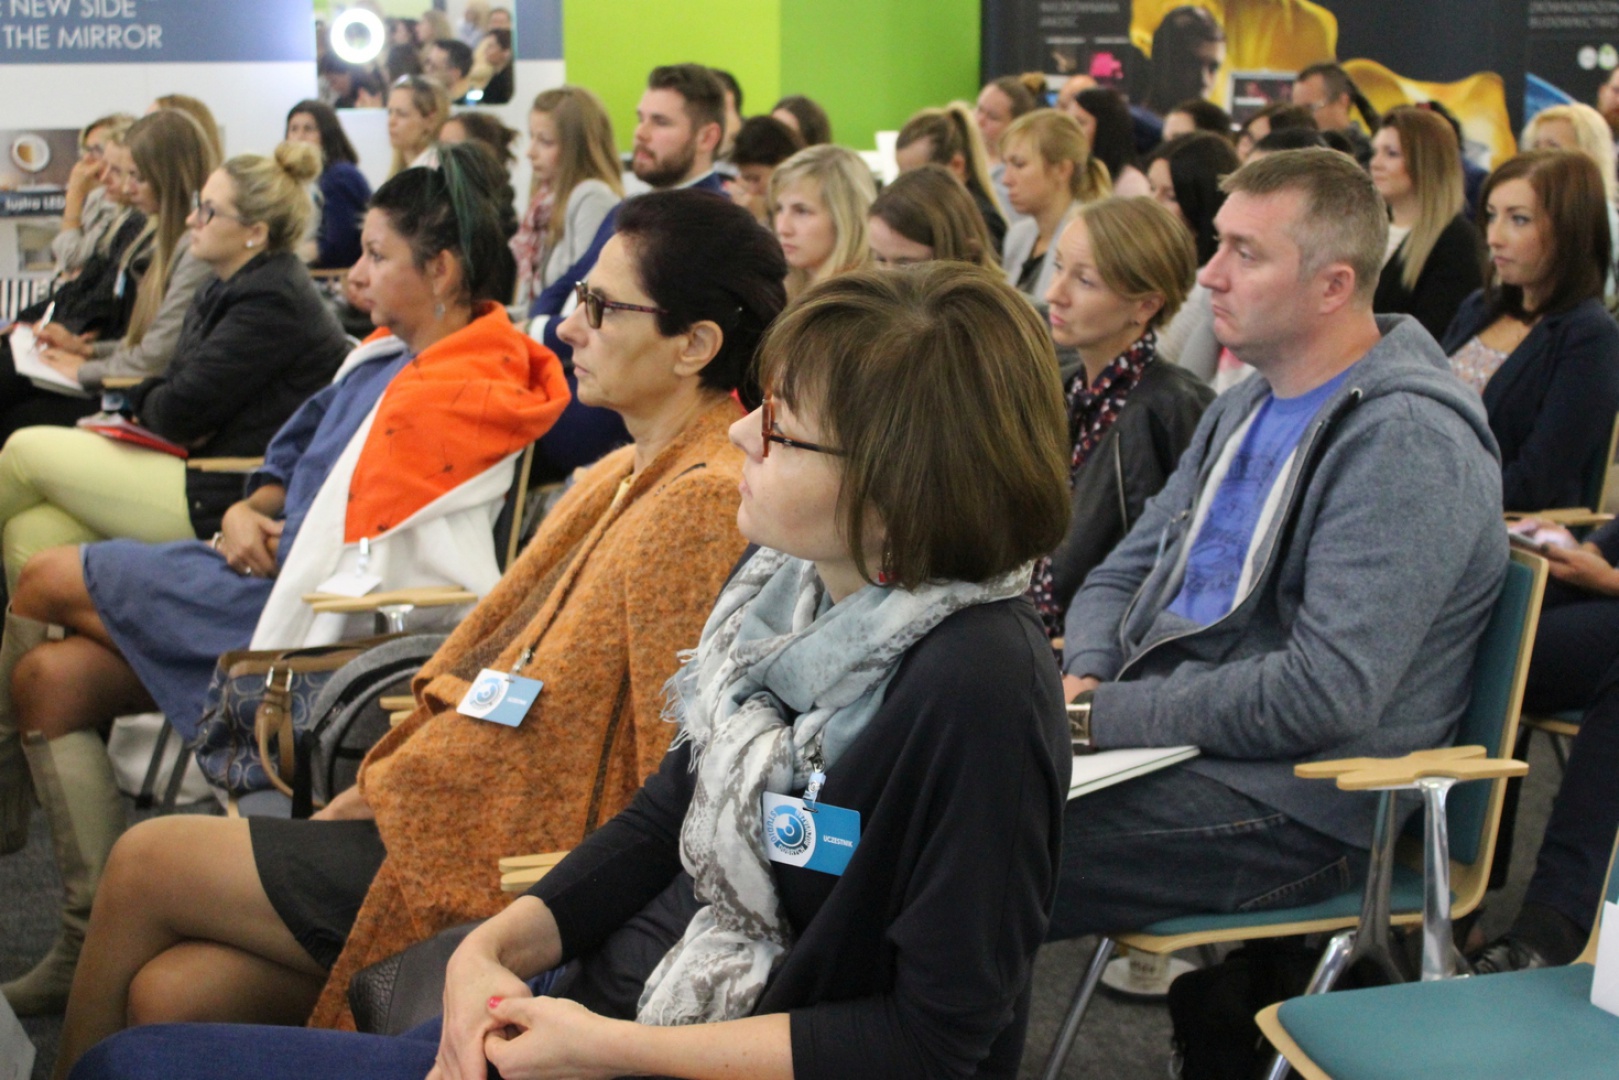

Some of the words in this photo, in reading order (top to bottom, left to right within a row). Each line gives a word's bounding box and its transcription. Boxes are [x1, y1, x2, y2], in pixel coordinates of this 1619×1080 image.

[10, 0, 71, 17] NEW
[80, 0, 137, 17] SIDE
[2, 24, 50, 49] THE
[57, 24, 163, 49] MIRROR
